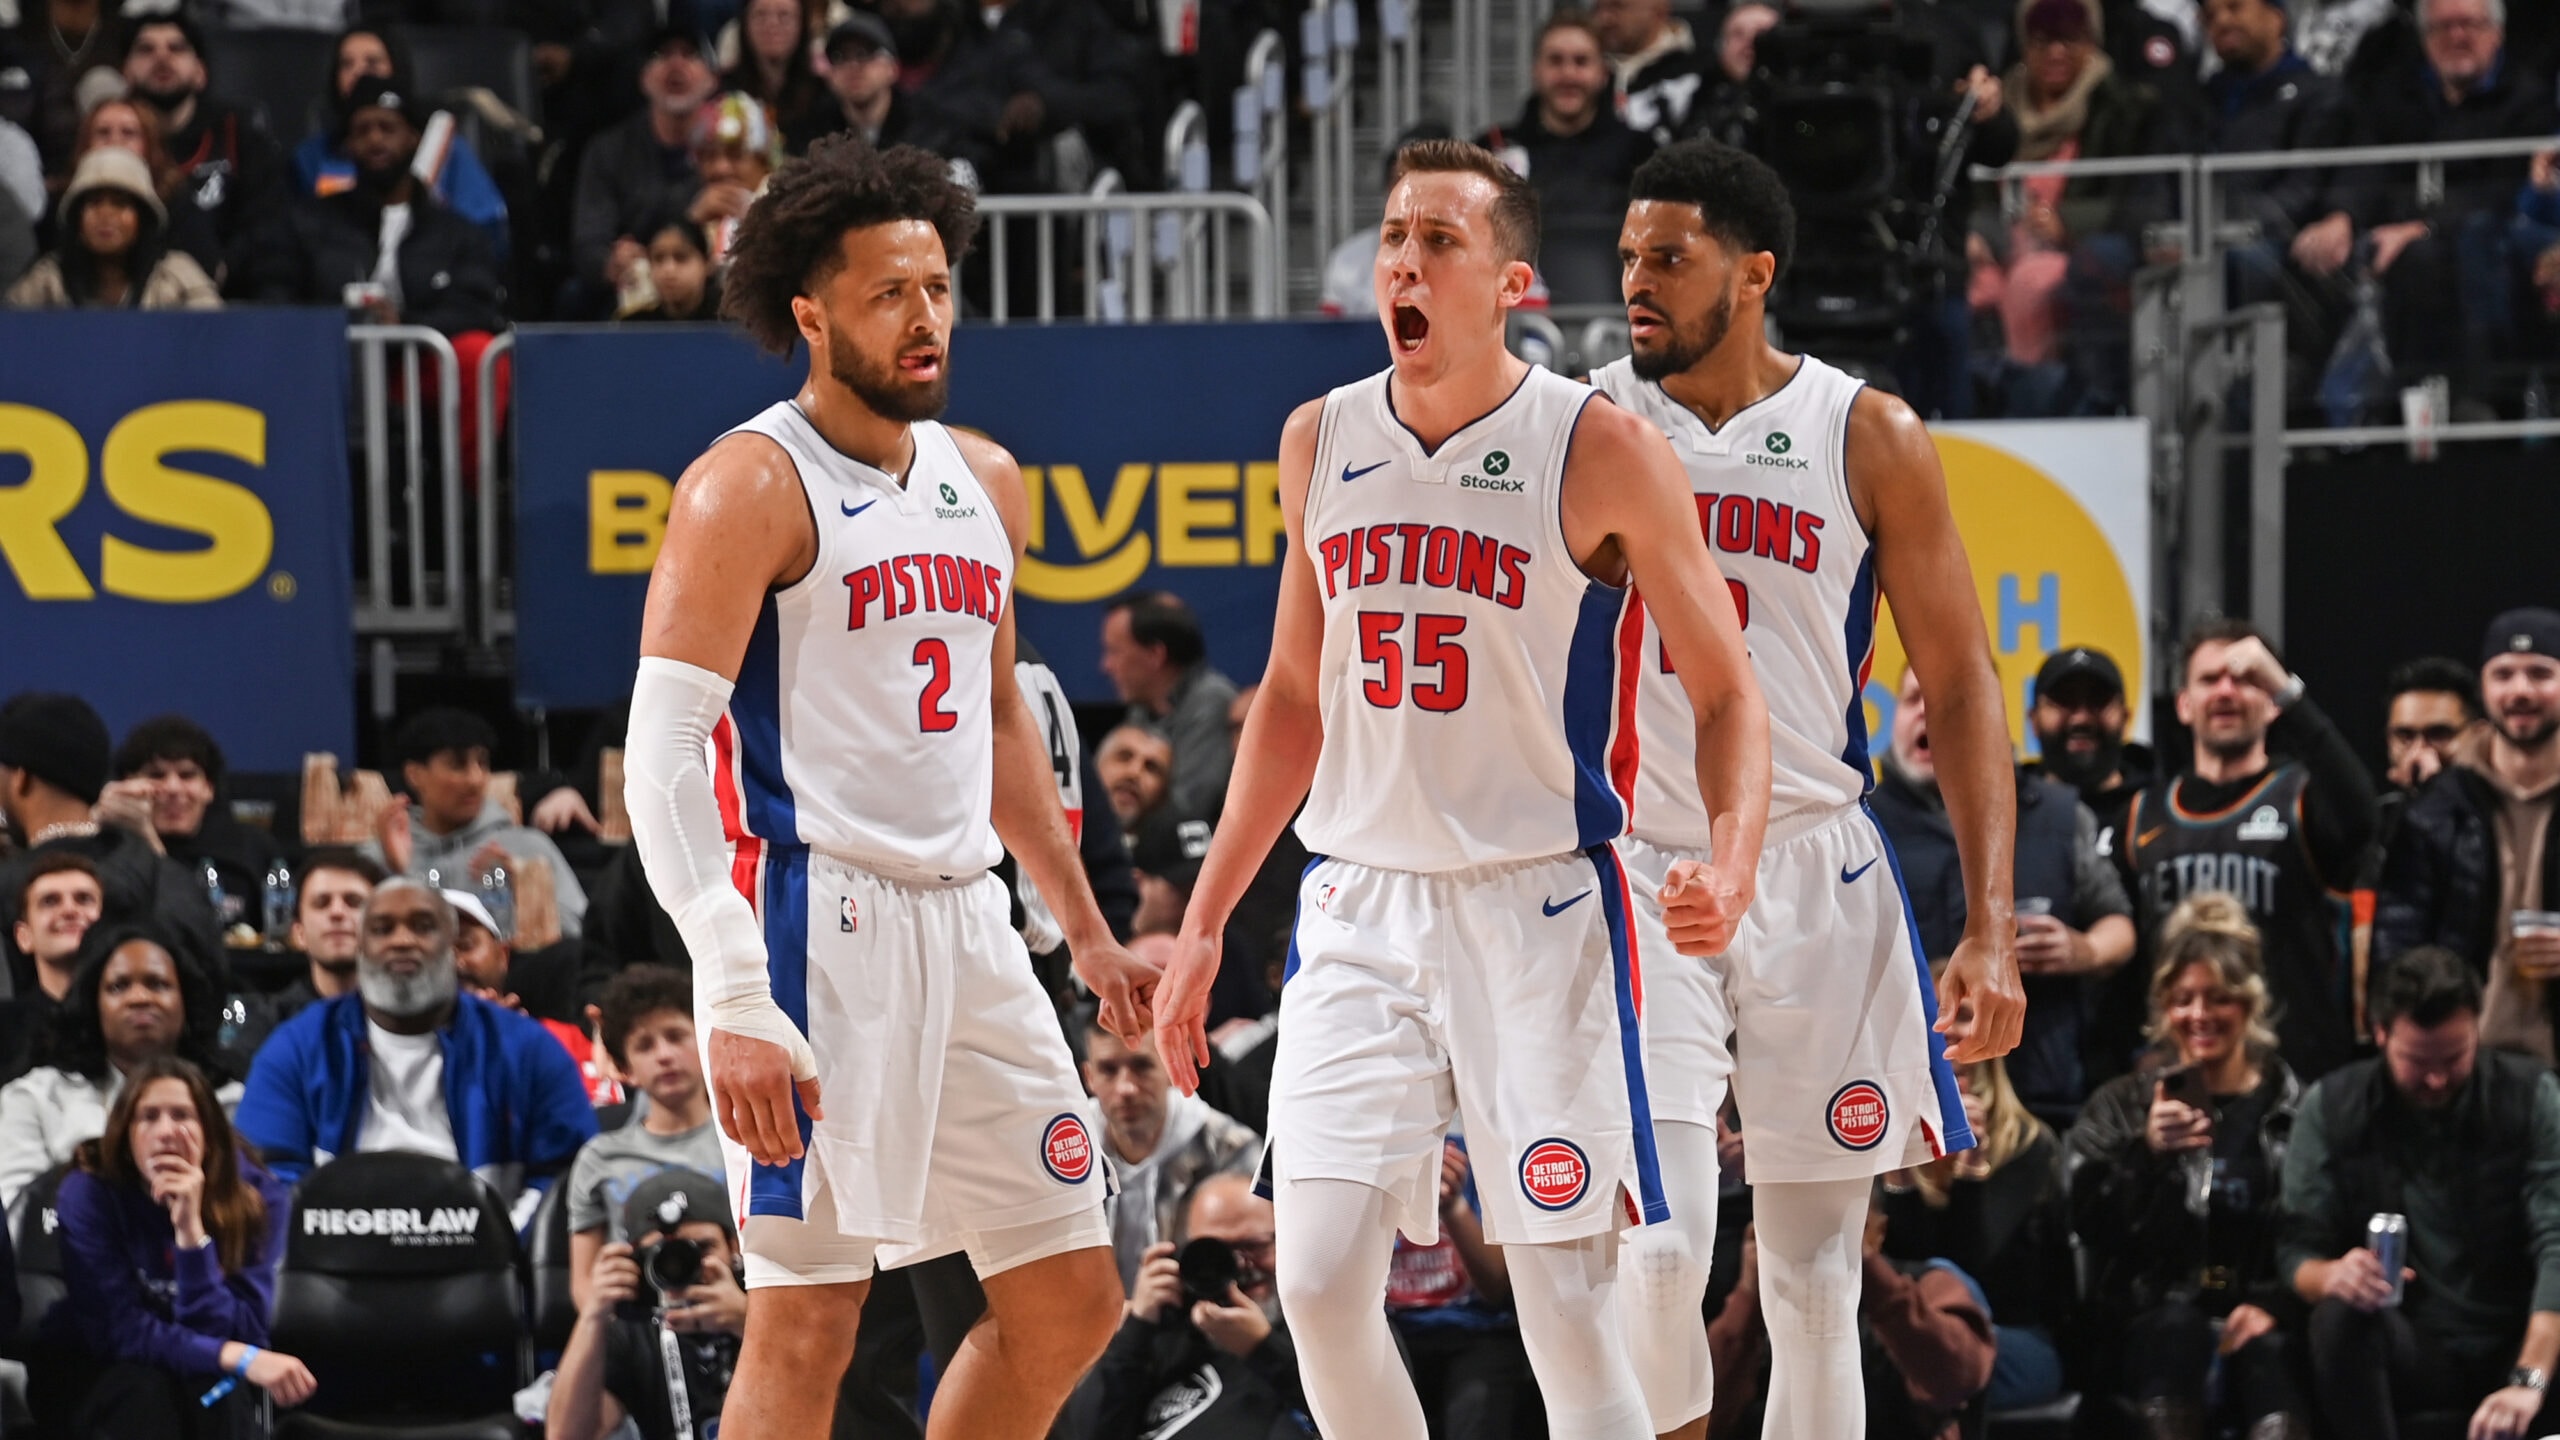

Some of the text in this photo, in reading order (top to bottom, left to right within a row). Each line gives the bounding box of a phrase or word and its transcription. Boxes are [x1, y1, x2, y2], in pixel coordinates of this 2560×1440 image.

[1747, 454, 1809, 470] StockX
[1460, 475, 1525, 493] StockX
[935, 507, 978, 519] StockX
[1319, 523, 1531, 610] PISTONS
[842, 553, 1002, 631] PISTONS
[1357, 611, 1469, 713] 55
[912, 637, 958, 733] 2
[1840, 1102, 1878, 1117] DETROIT
[1841, 1113, 1880, 1129] PISTONS
[1052, 1134, 1083, 1152] DETROIT
[1055, 1146, 1087, 1164] PISTONS
[1531, 1160, 1575, 1176] DETROIT
[1533, 1172, 1577, 1188] PISTONS
